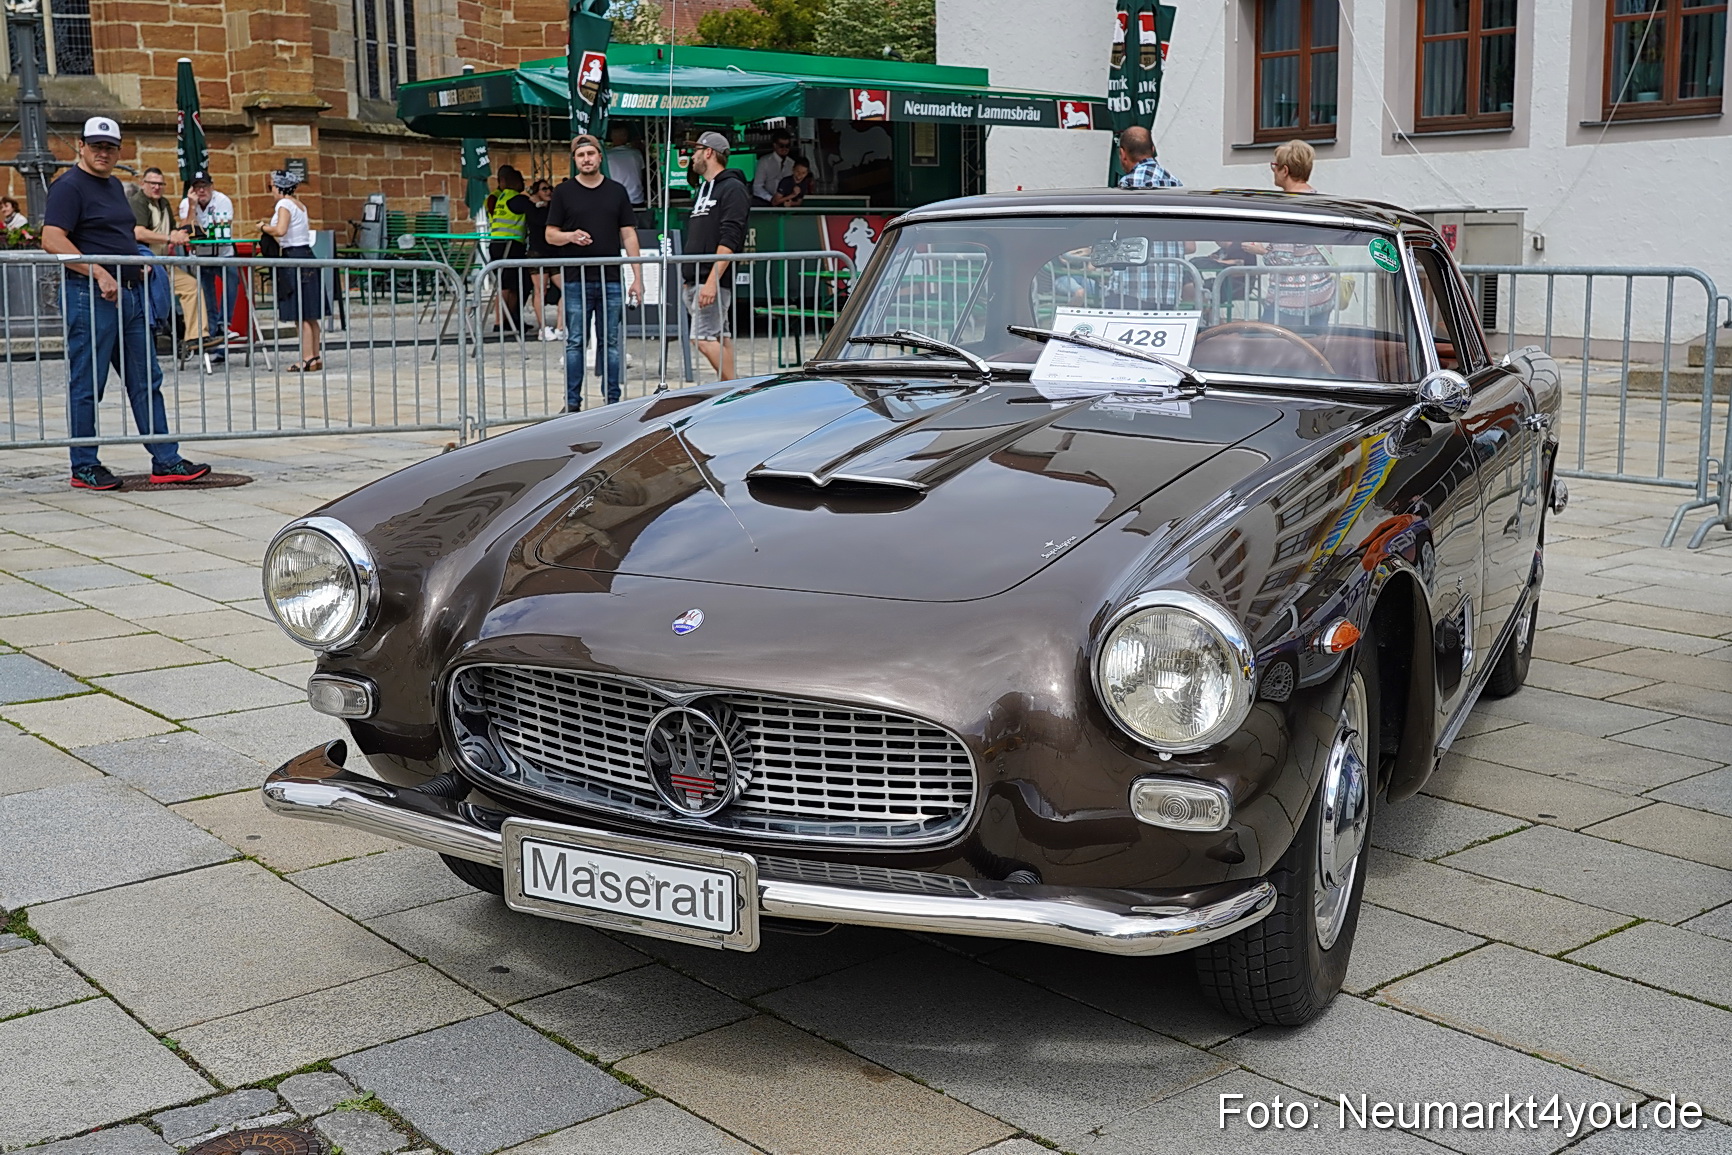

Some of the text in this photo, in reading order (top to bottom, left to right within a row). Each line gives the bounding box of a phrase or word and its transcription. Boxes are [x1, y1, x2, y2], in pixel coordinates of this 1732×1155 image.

[621, 93, 658, 109] BIOBIER
[660, 95, 710, 109] GENIESSER
[903, 100, 1041, 121] Neumarkter Lammsbräu
[1117, 328, 1168, 348] 428
[531, 846, 725, 923] Maserati
